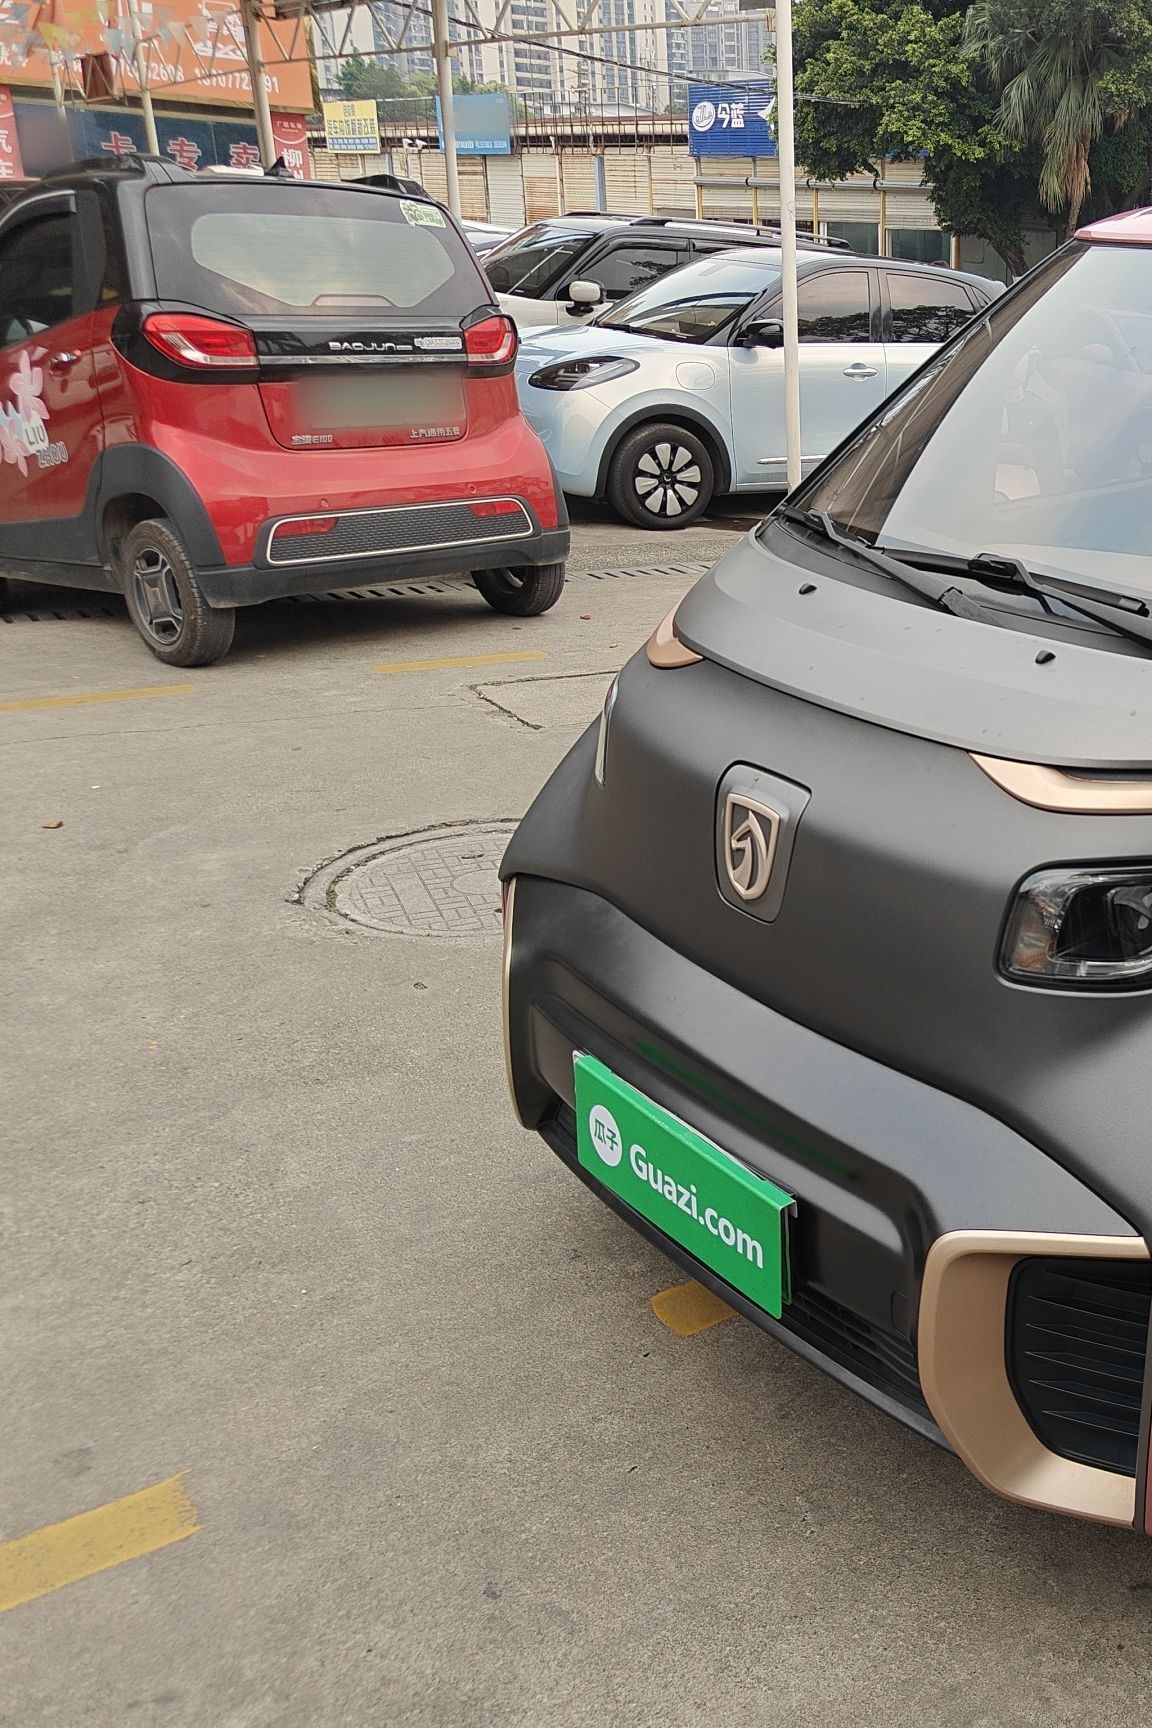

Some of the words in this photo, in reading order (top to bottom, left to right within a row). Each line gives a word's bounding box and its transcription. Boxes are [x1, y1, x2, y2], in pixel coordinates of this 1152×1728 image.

[328, 341, 397, 351] BAOJUN
[24, 424, 46, 446] LIU
[409, 426, 461, 439] 上汽通用五菱
[593, 1117, 619, 1152] 瓜子
[630, 1143, 764, 1270] Guazi.com
